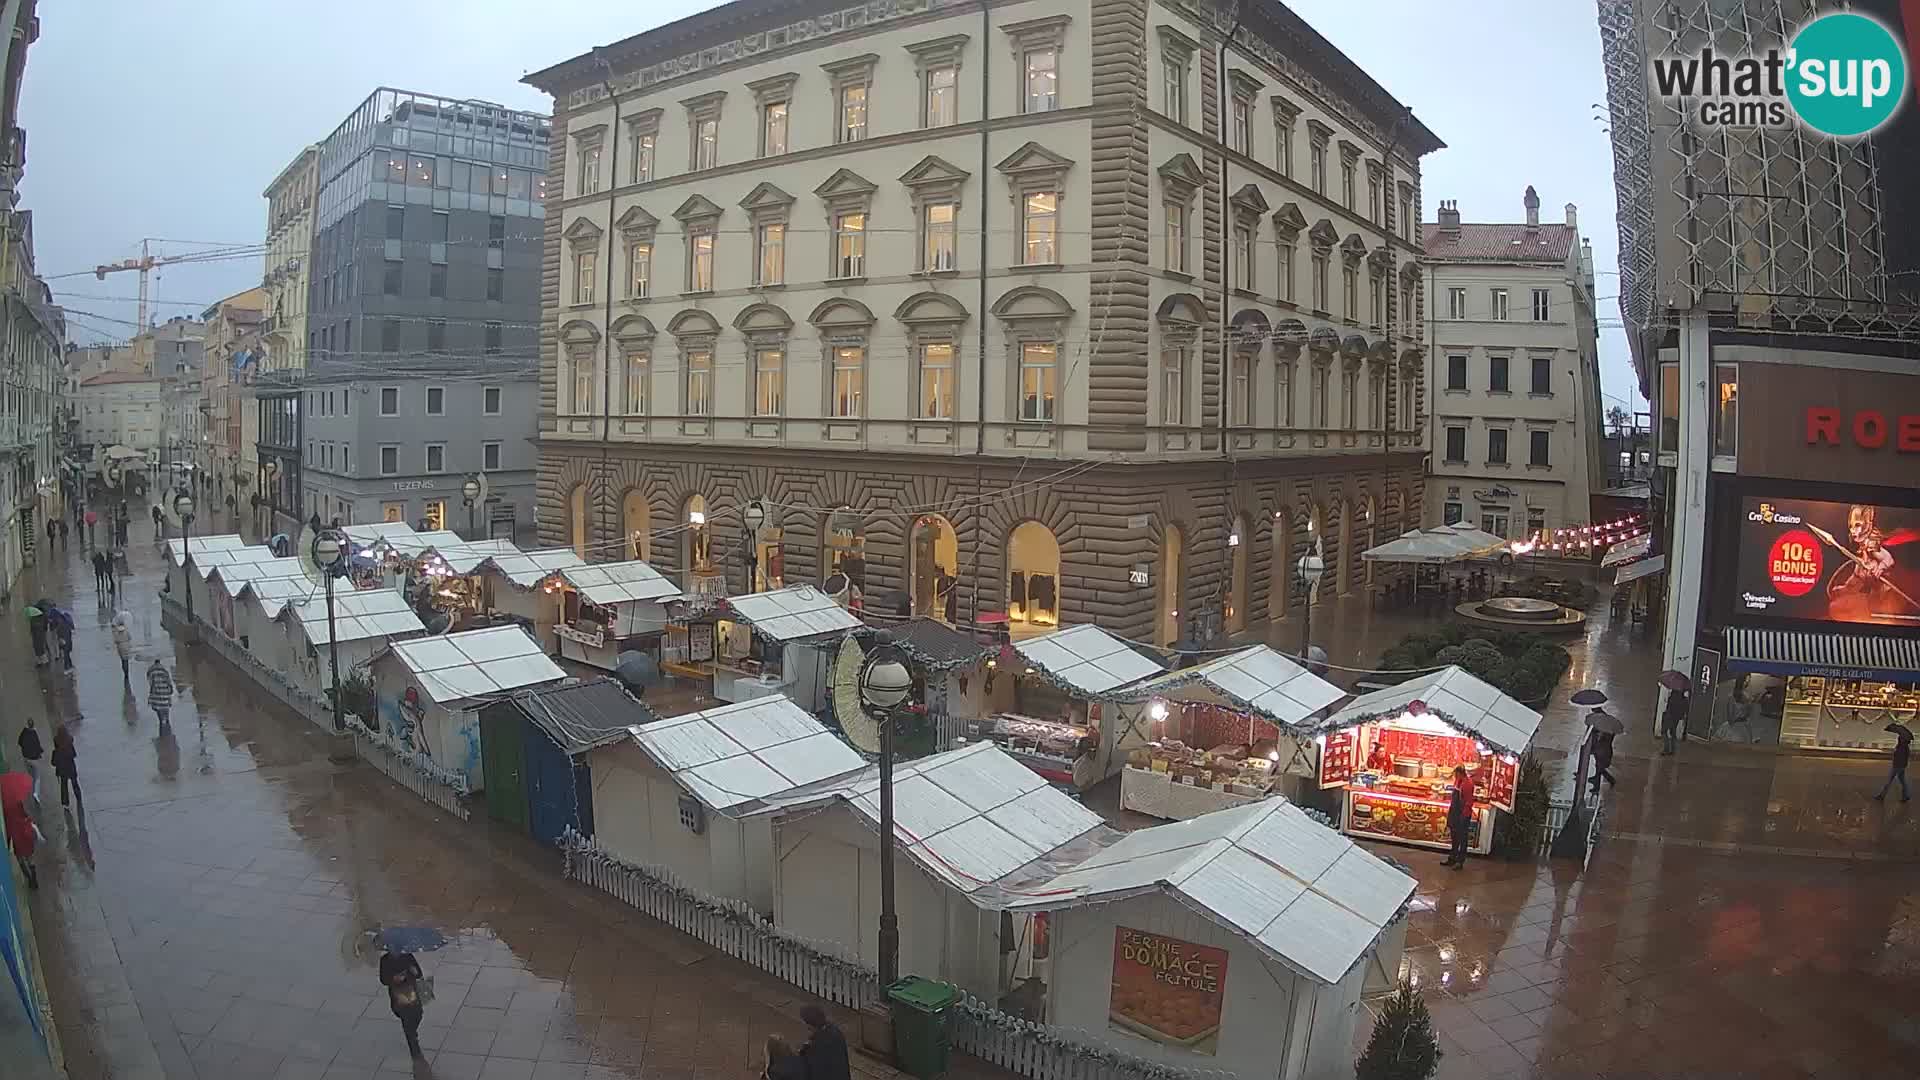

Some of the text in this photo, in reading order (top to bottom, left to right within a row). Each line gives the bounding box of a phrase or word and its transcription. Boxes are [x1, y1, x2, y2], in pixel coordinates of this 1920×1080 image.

[392, 480, 434, 491] TEZENIS
[1748, 512, 1800, 523] Cro Casino
[1781, 542, 1813, 562] 10€
[1773, 560, 1817, 576] BONUS
[1123, 931, 1182, 955] PERINE
[1123, 944, 1219, 979] DOMAĆE
[1155, 971, 1217, 993] FRITULE
